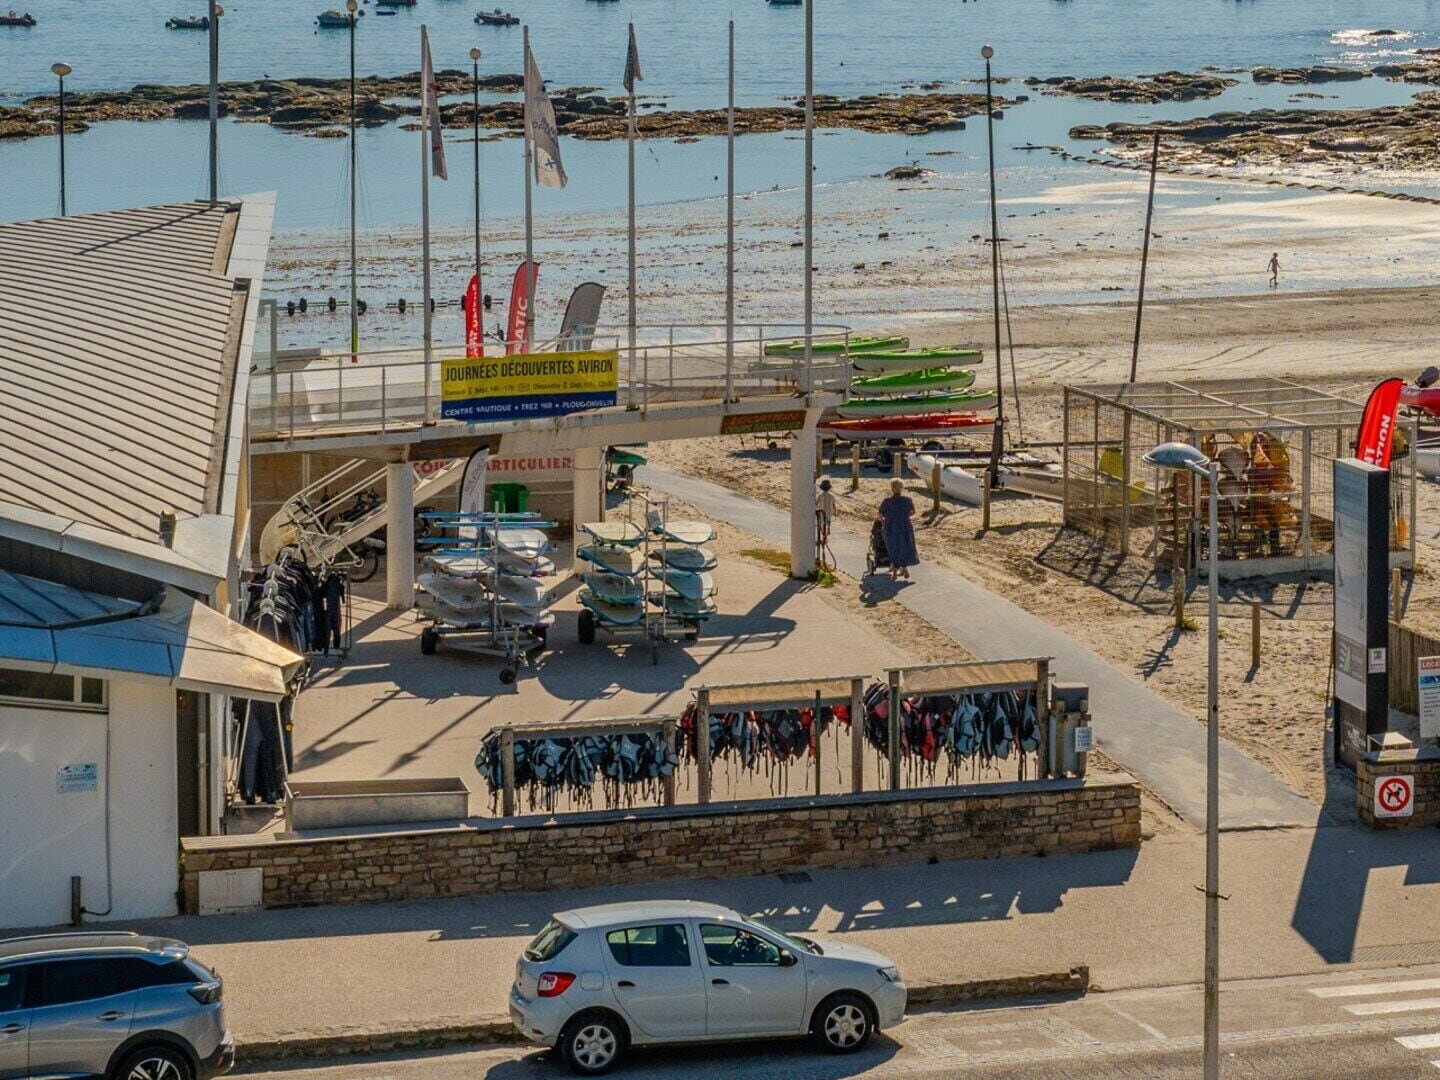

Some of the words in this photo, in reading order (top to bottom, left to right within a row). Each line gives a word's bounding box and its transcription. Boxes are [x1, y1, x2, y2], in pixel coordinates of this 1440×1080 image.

[444, 361, 498, 383] JOURNÉES
[501, 360, 575, 378] DÉCOUVERTES
[577, 359, 614, 374] AVIRON
[444, 406, 474, 417] CENTRE
[562, 399, 615, 409] PLOUGONVELIN
